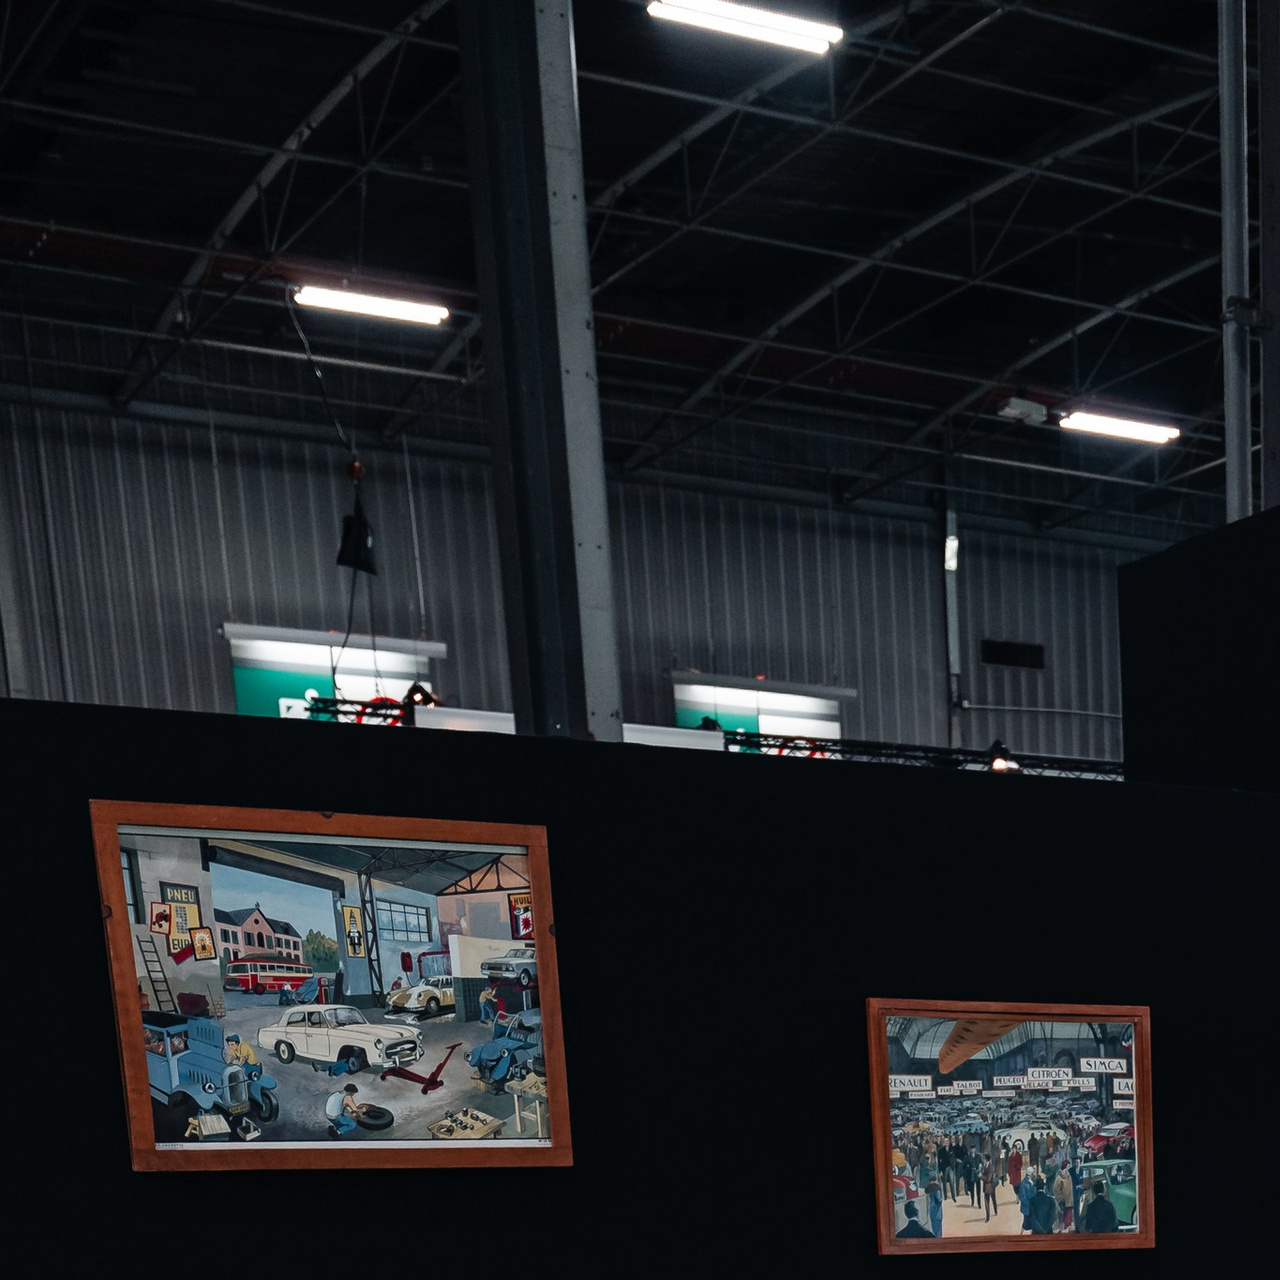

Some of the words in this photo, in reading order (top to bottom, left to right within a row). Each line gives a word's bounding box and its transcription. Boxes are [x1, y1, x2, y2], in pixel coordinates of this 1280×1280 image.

[166, 888, 195, 902] PNEU
[1085, 1060, 1124, 1071] SIMCA
[889, 1078, 928, 1088] RENAULT
[995, 1076, 1025, 1085] PEUGEOT
